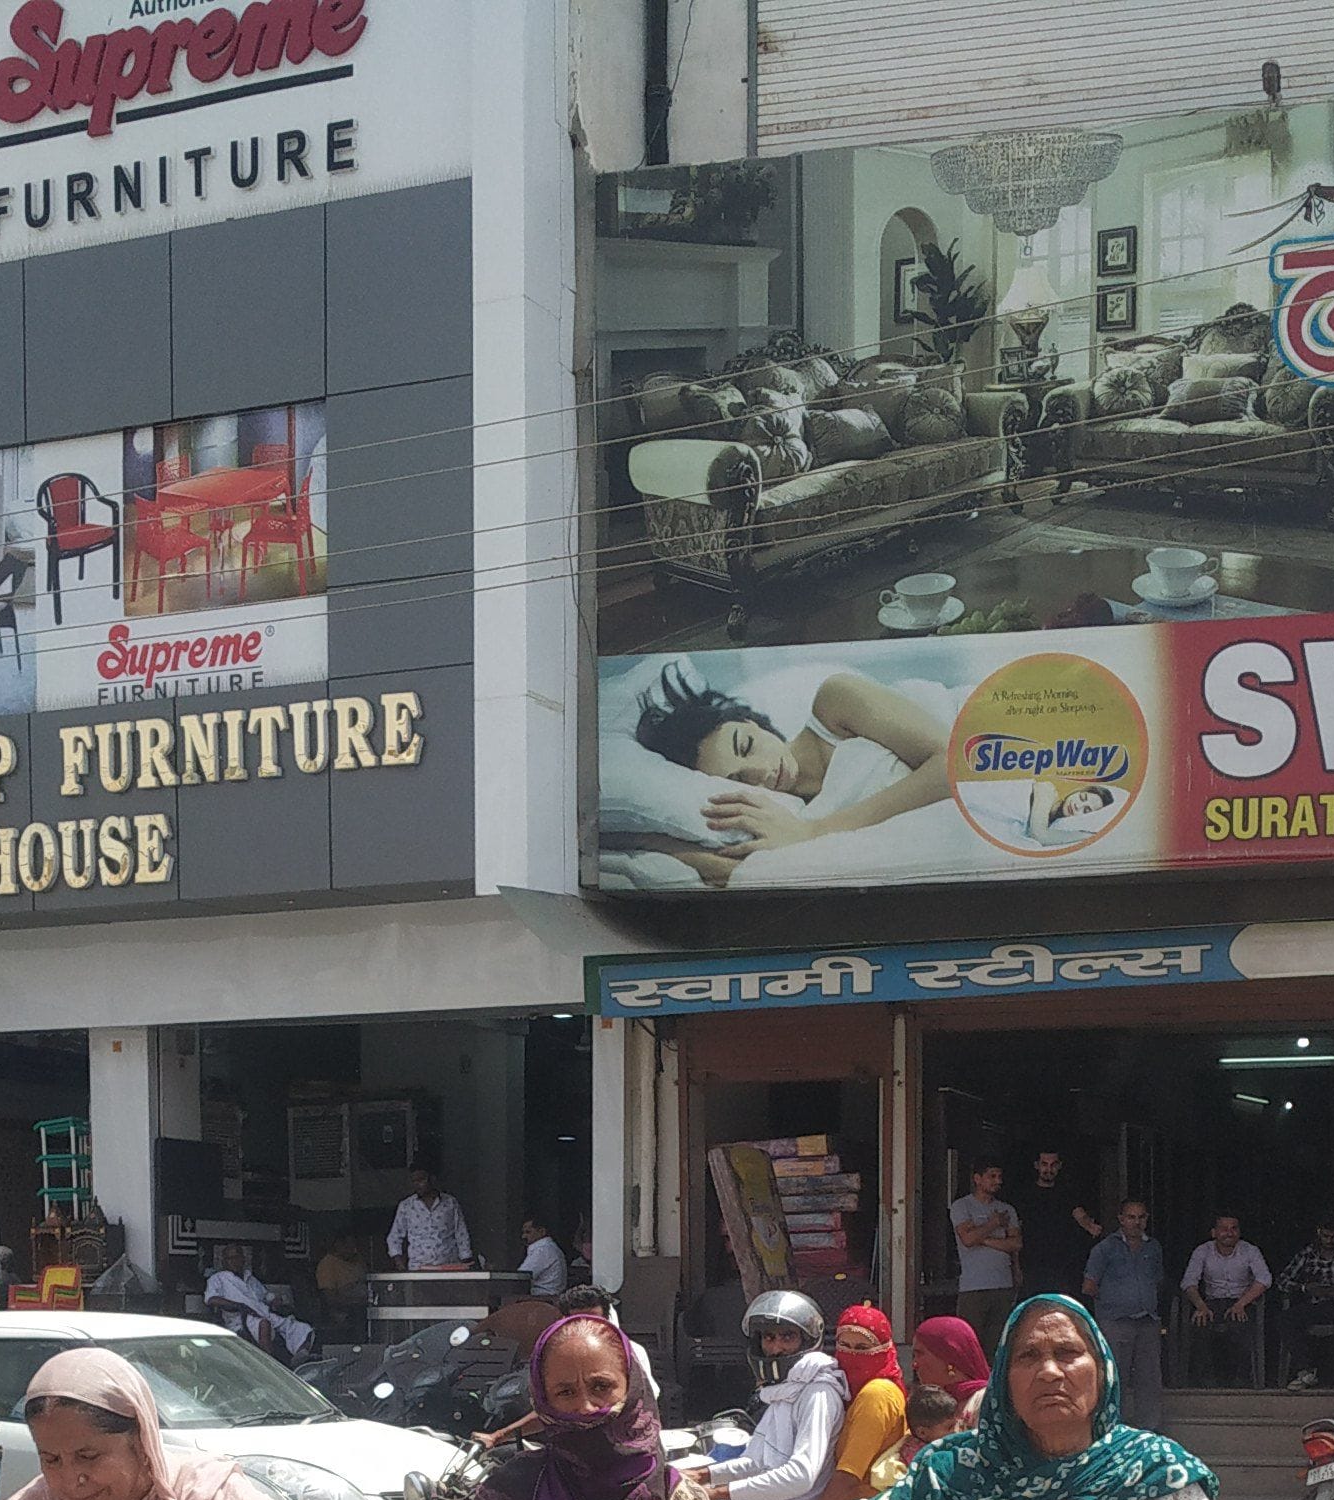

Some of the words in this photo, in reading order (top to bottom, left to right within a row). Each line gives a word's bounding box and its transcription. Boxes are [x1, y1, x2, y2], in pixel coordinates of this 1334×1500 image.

[97, 624, 263, 688] Supreme
[97, 671, 264, 705] FURNITURE
[59, 690, 424, 797] FURNITURE
[974, 739, 1119, 777] SleepWay
[608, 956, 882, 1008] स्वामी
[905, 943, 1213, 990] स्टील्स
